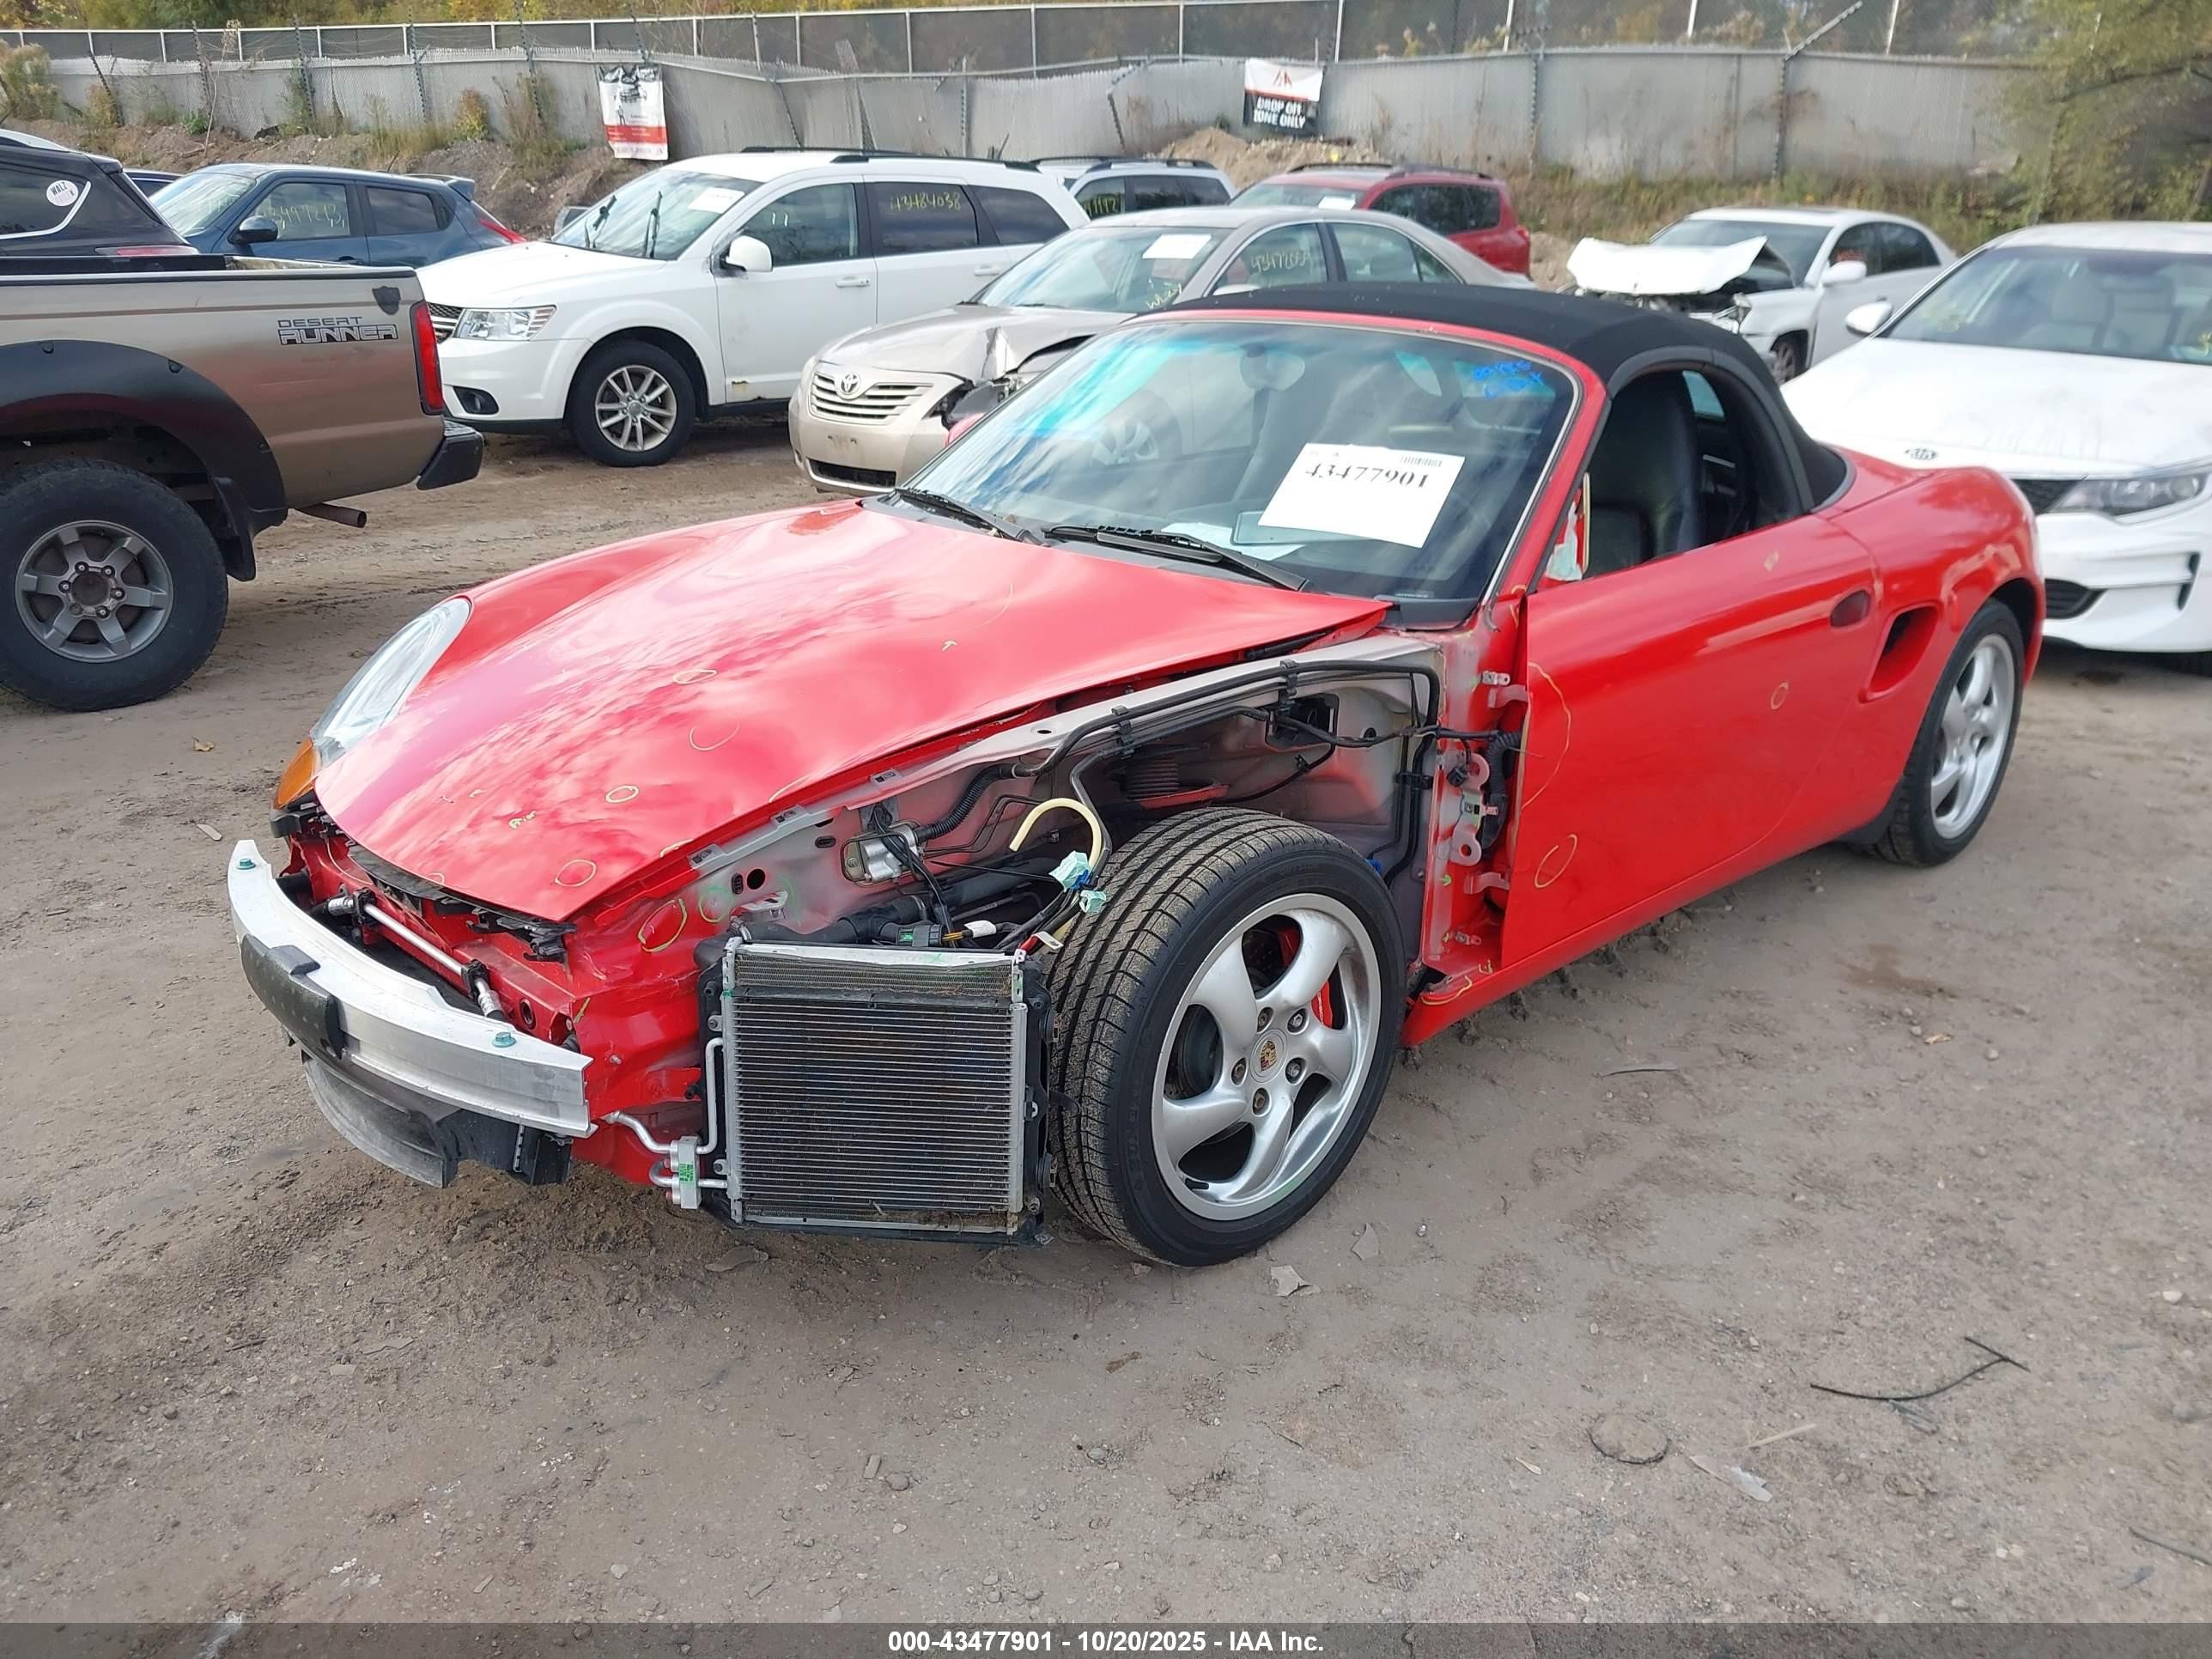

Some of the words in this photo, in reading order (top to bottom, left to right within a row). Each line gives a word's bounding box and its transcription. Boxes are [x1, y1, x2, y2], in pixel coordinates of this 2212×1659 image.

[1279, 112, 1306, 129] ONLY
[277, 316, 362, 328] DESERT
[278, 324, 399, 345] RUNNER
[1305, 463, 1429, 489] 43477901
